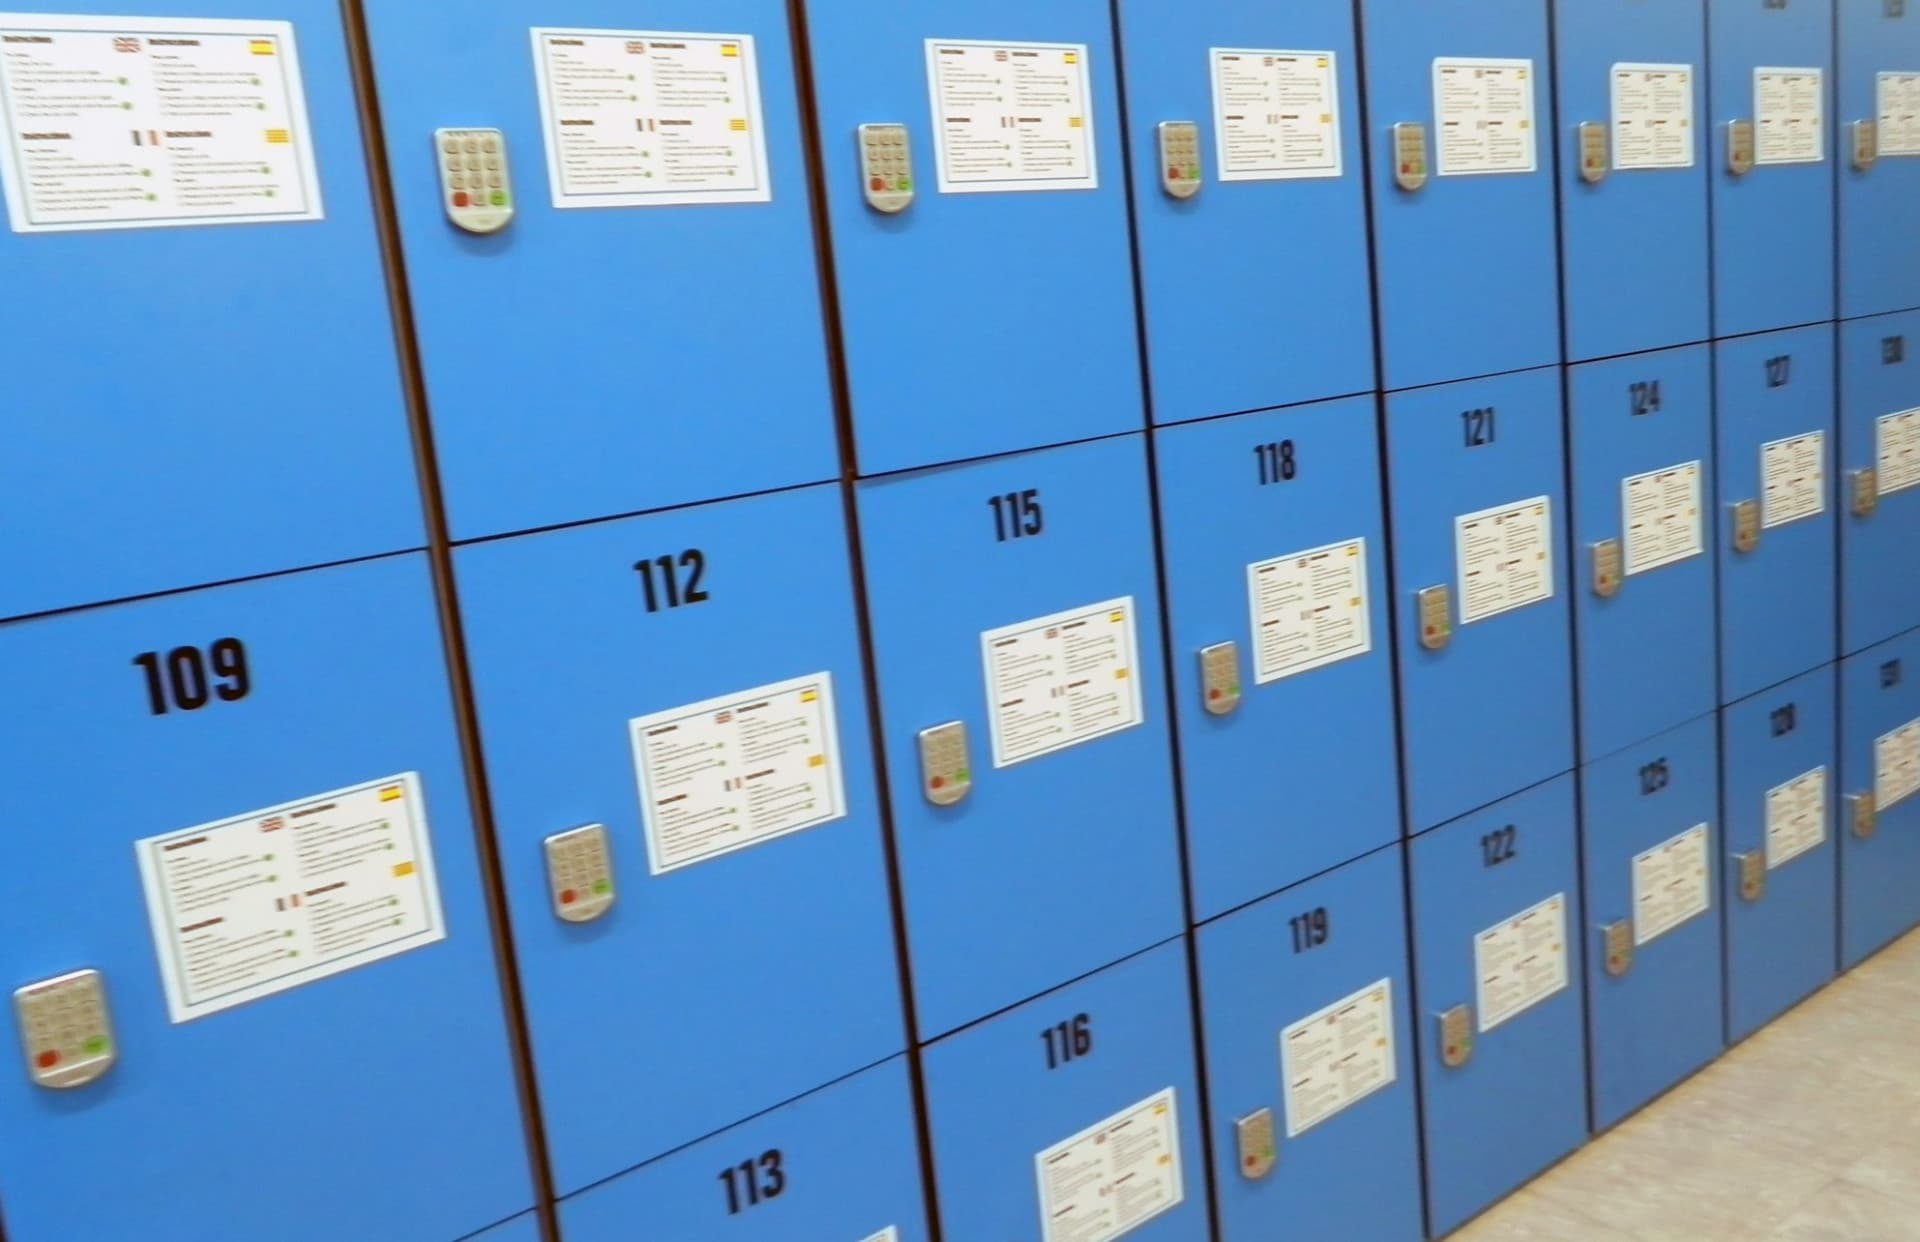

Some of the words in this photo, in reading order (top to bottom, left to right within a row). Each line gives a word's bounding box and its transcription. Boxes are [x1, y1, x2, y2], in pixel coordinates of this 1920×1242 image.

[1629, 380, 1661, 416] 124
[1462, 407, 1495, 447] 121
[1254, 439, 1296, 485] 118
[988, 488, 1043, 542] 115
[634, 549, 709, 612] 112
[133, 637, 251, 716] 109
[1480, 824, 1517, 867] 122
[1289, 907, 1329, 953] 119
[1041, 1013, 1092, 1069] 116
[719, 1149, 785, 1215] 113
